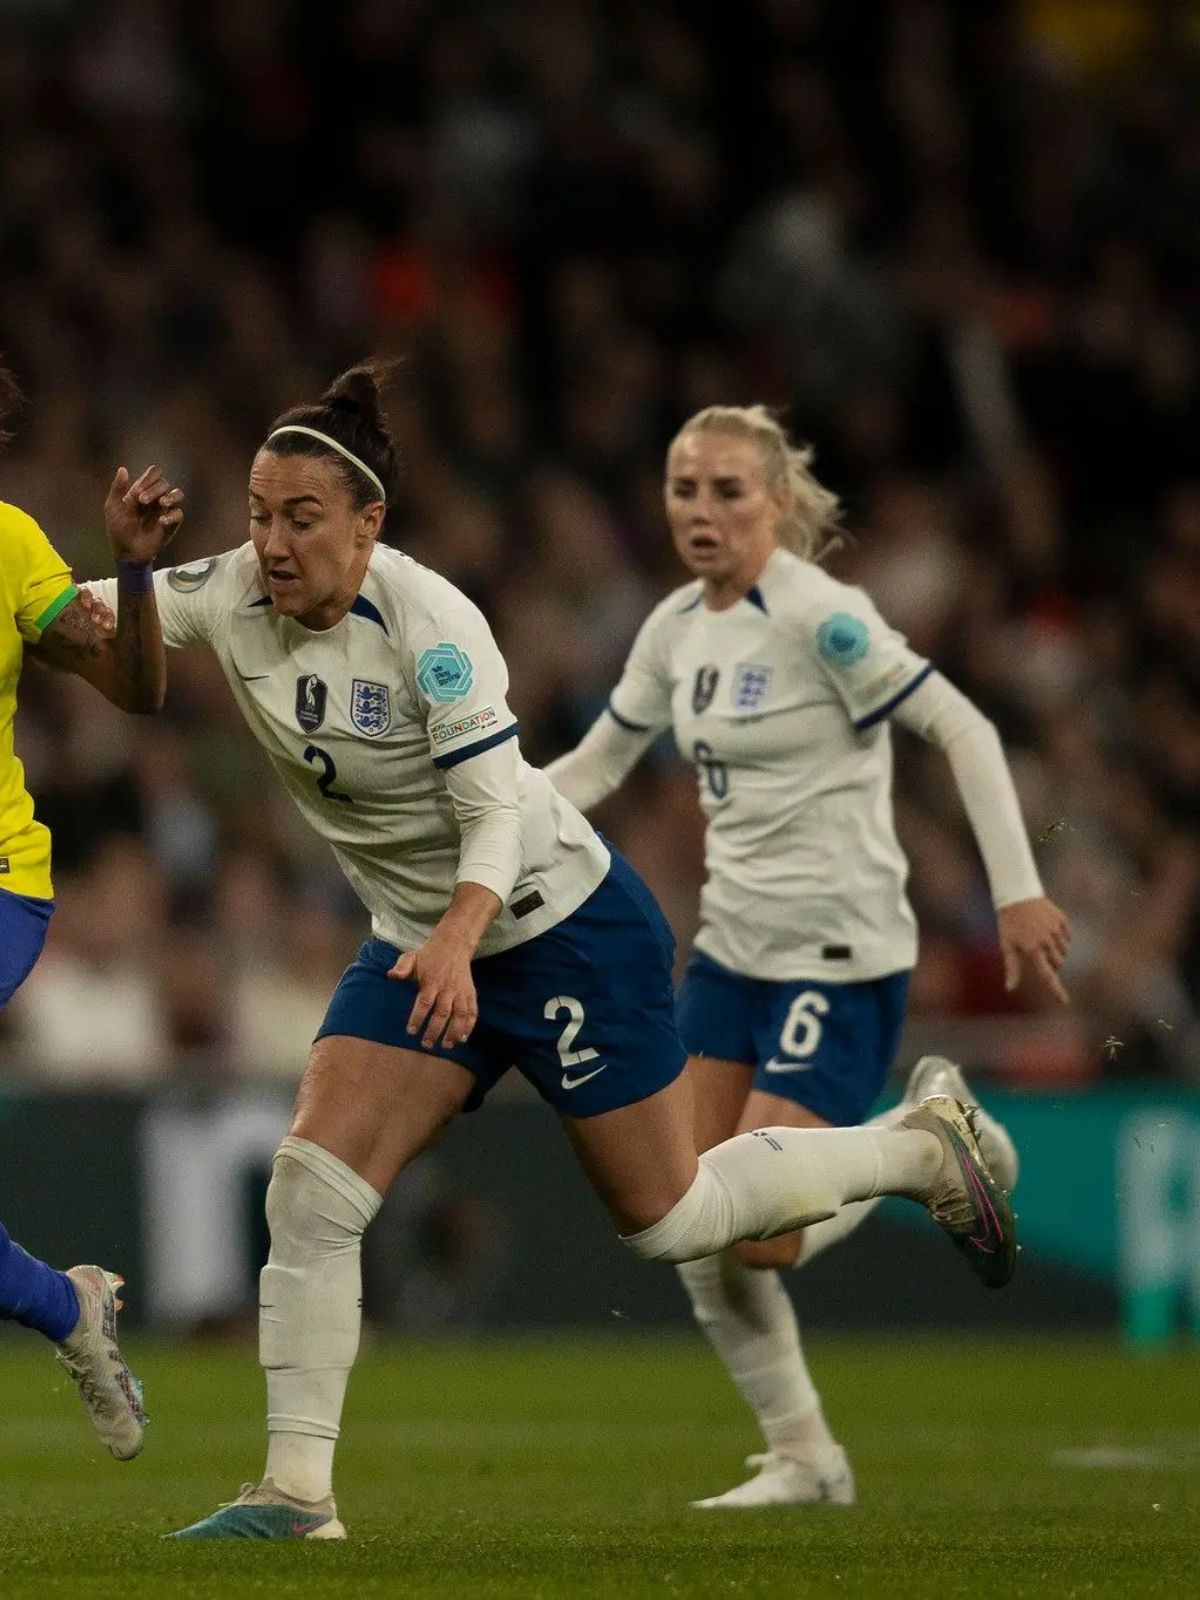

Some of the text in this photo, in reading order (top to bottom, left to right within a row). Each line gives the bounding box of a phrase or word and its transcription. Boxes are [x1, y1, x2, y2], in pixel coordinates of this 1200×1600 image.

[432, 708, 497, 744] FOUNDATION
[303, 745, 353, 803] 2
[543, 995, 600, 1067] 2
[779, 991, 830, 1057] 6
